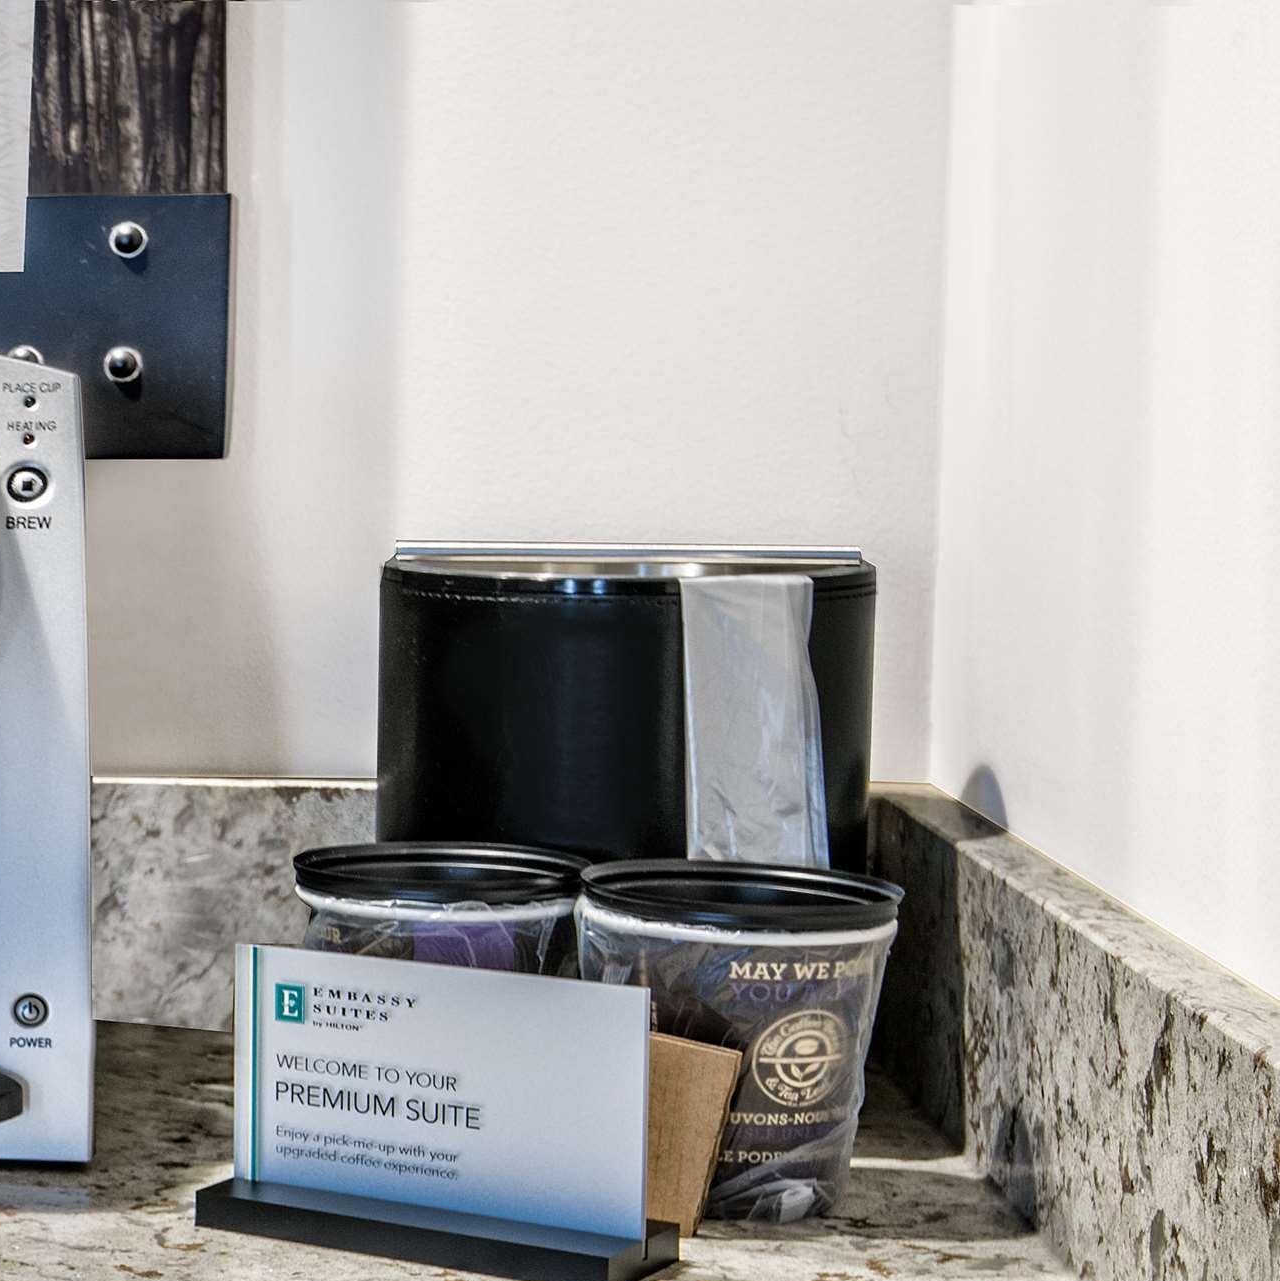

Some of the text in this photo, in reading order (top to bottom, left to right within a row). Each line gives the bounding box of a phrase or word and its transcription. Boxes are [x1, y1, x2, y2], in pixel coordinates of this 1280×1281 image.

[2, 382, 62, 393] PLACE CUP
[7, 421, 57, 432] HEATING
[6, 516, 52, 530] BREW
[729, 961, 787, 980] MAY
[792, 962, 831, 980] WE
[313, 987, 417, 1008] EMBASSY
[313, 1004, 389, 1022] SUITES
[325, 1021, 360, 1031] HILTON
[9, 1037, 52, 1048] POWER
[276, 1053, 457, 1092] WELCOME TO YOUR
[275, 1081, 481, 1130] PREMIUM SUITE
[276, 1125, 458, 1163] Enjoy a pick-me-up with your
[276, 1145, 337, 1162] upgraded
[340, 1153, 381, 1169] coffee
